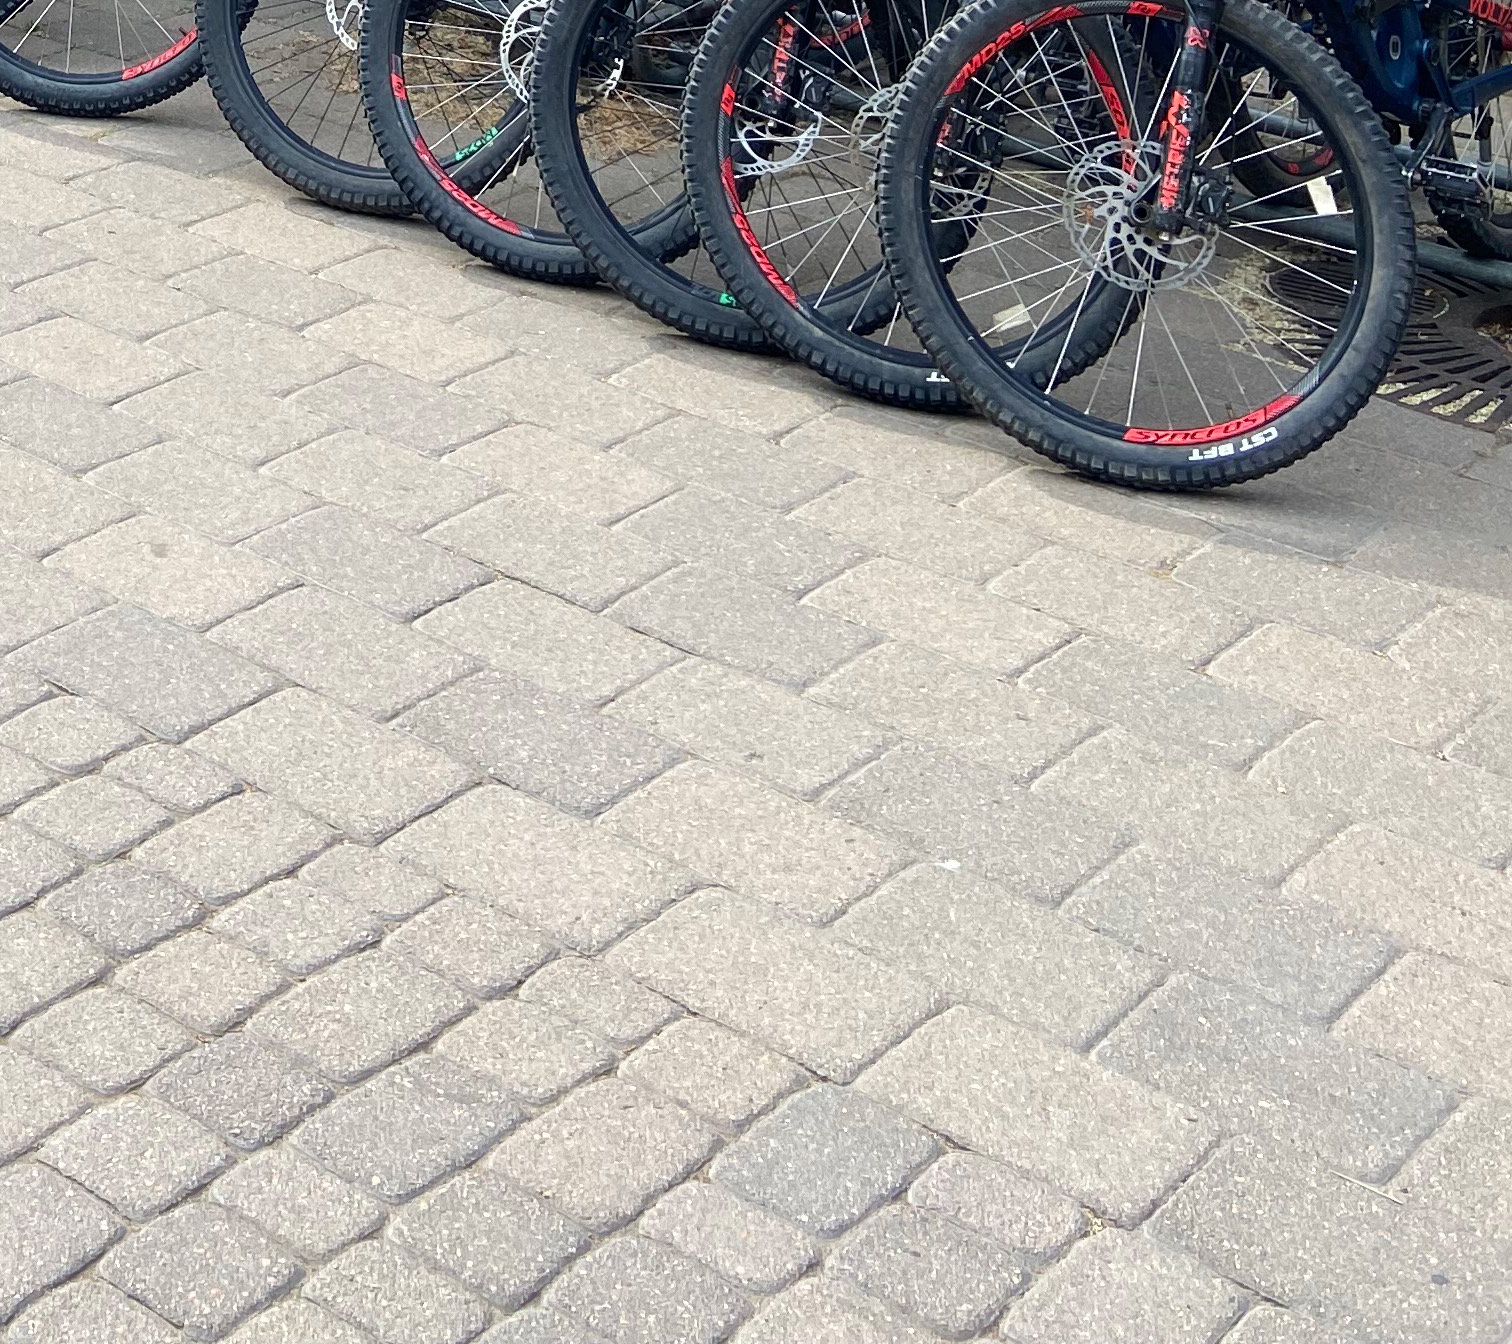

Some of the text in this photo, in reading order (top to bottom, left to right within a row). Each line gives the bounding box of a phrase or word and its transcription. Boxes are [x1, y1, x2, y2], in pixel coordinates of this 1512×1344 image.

[962, 19, 1028, 75] MD25
[1188, 425, 1279, 462] CST BFT
